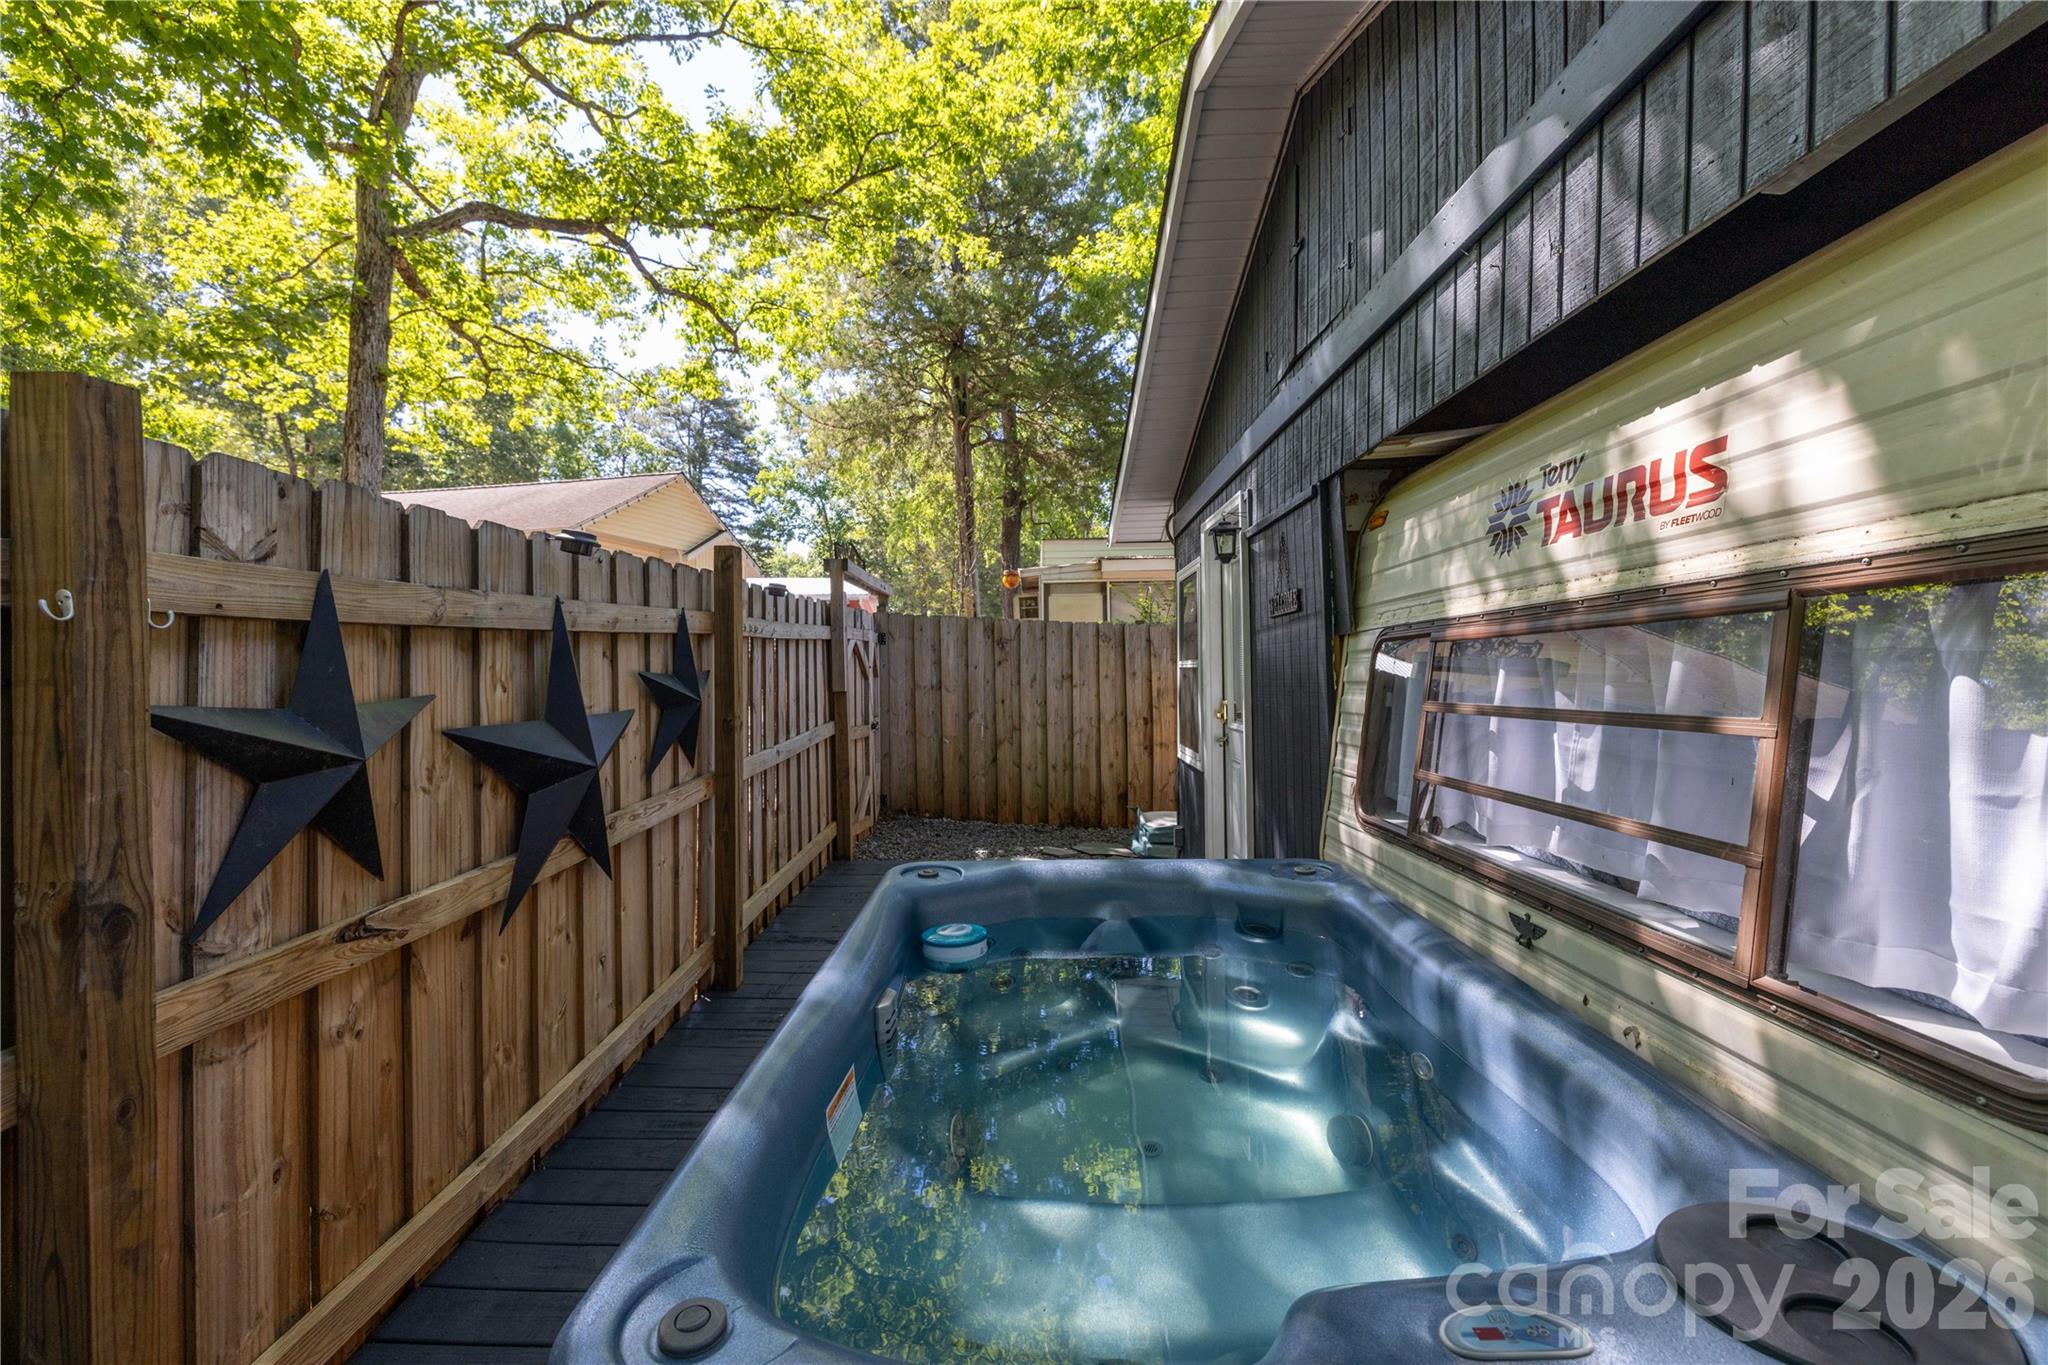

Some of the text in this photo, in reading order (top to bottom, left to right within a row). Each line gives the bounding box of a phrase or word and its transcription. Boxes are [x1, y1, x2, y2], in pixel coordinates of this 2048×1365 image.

[1540, 452, 1587, 490] Terry
[1536, 435, 1729, 547] TAURUS
[1659, 507, 1723, 531] BY FLEETWOOD
